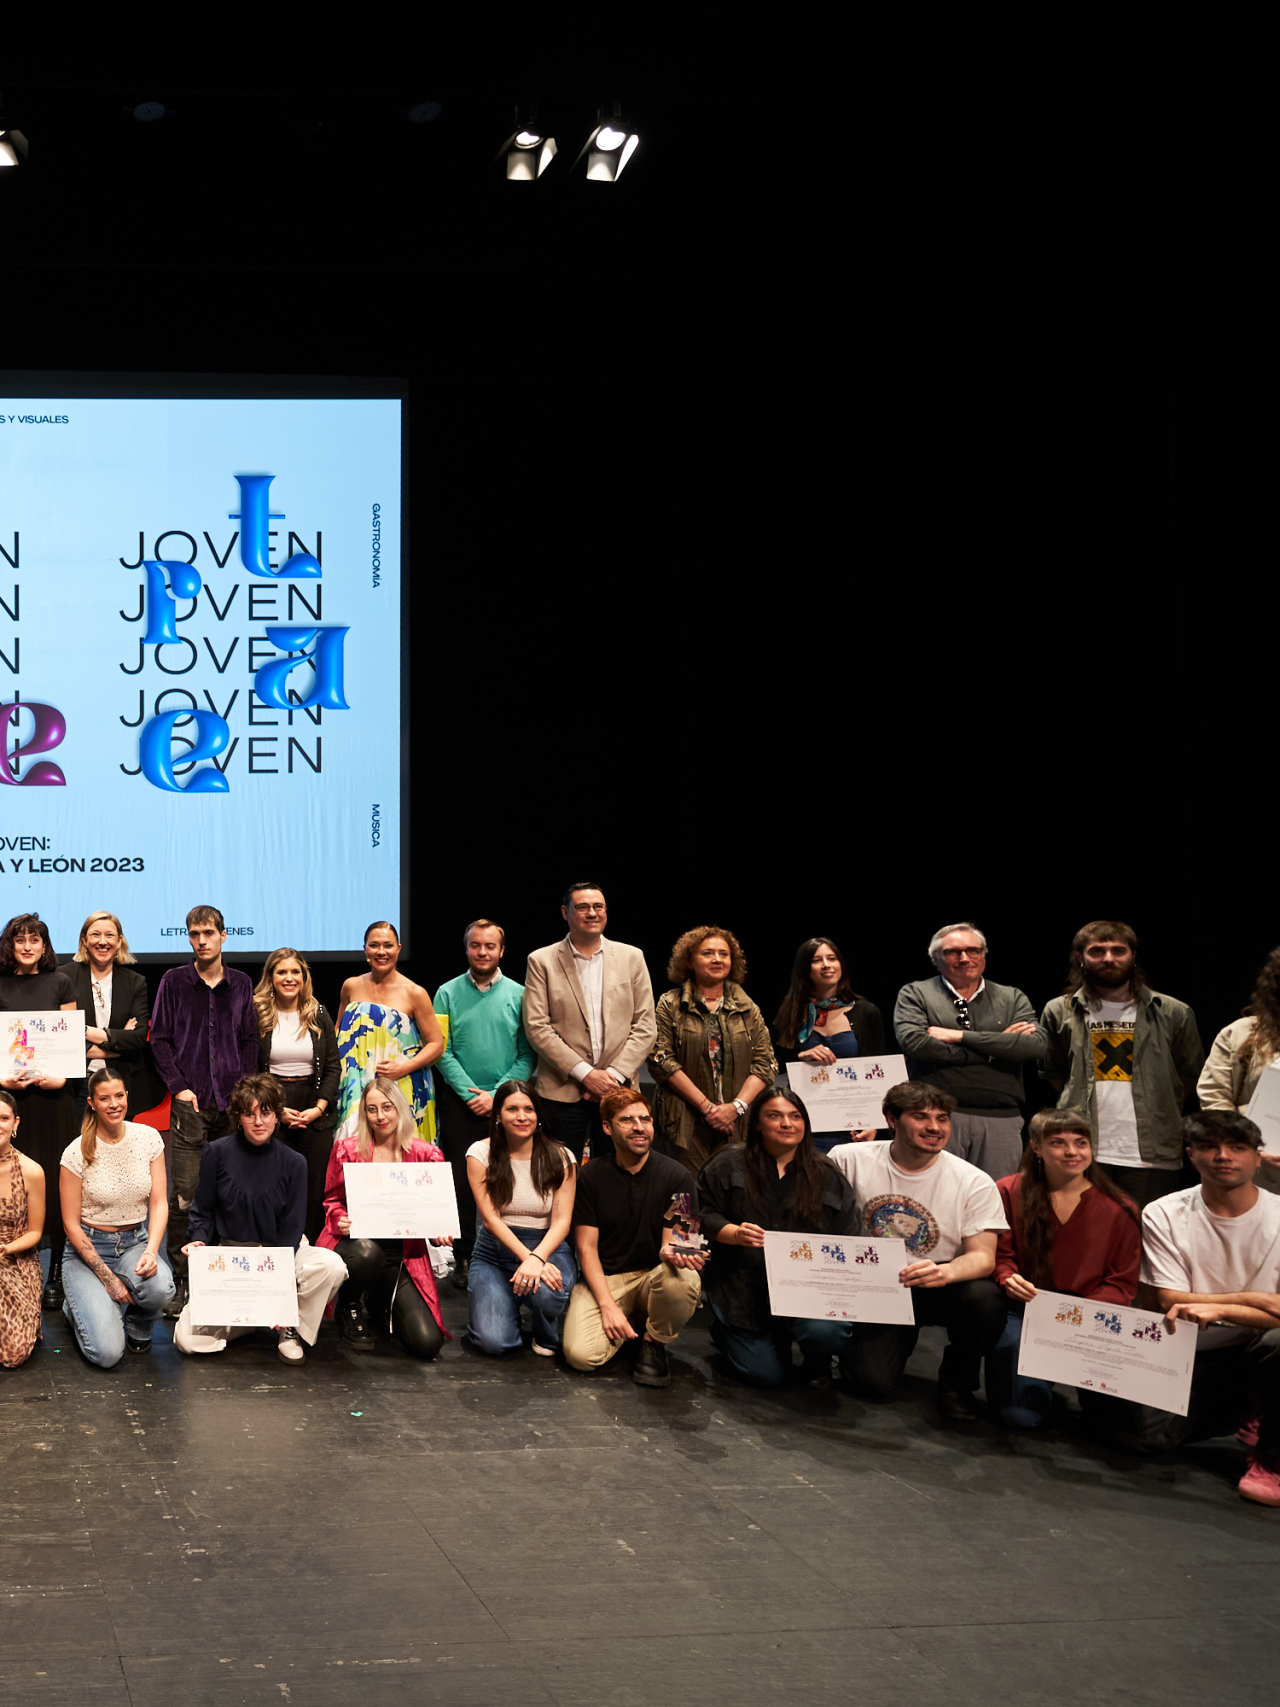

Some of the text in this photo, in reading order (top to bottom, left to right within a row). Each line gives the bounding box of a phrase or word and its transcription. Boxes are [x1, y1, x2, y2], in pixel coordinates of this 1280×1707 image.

[7, 415, 16, 424] Y
[17, 414, 69, 424] VISUALES
[371, 502, 382, 589] GASTRONOMÍA
[371, 803, 382, 848] MÚSICA
[9, 858, 24, 873] Y
[28, 855, 86, 873] LEÓN
[89, 857, 145, 873] 2023
[160, 928, 188, 936] LETR
[1090, 1021, 1103, 1030] AS
